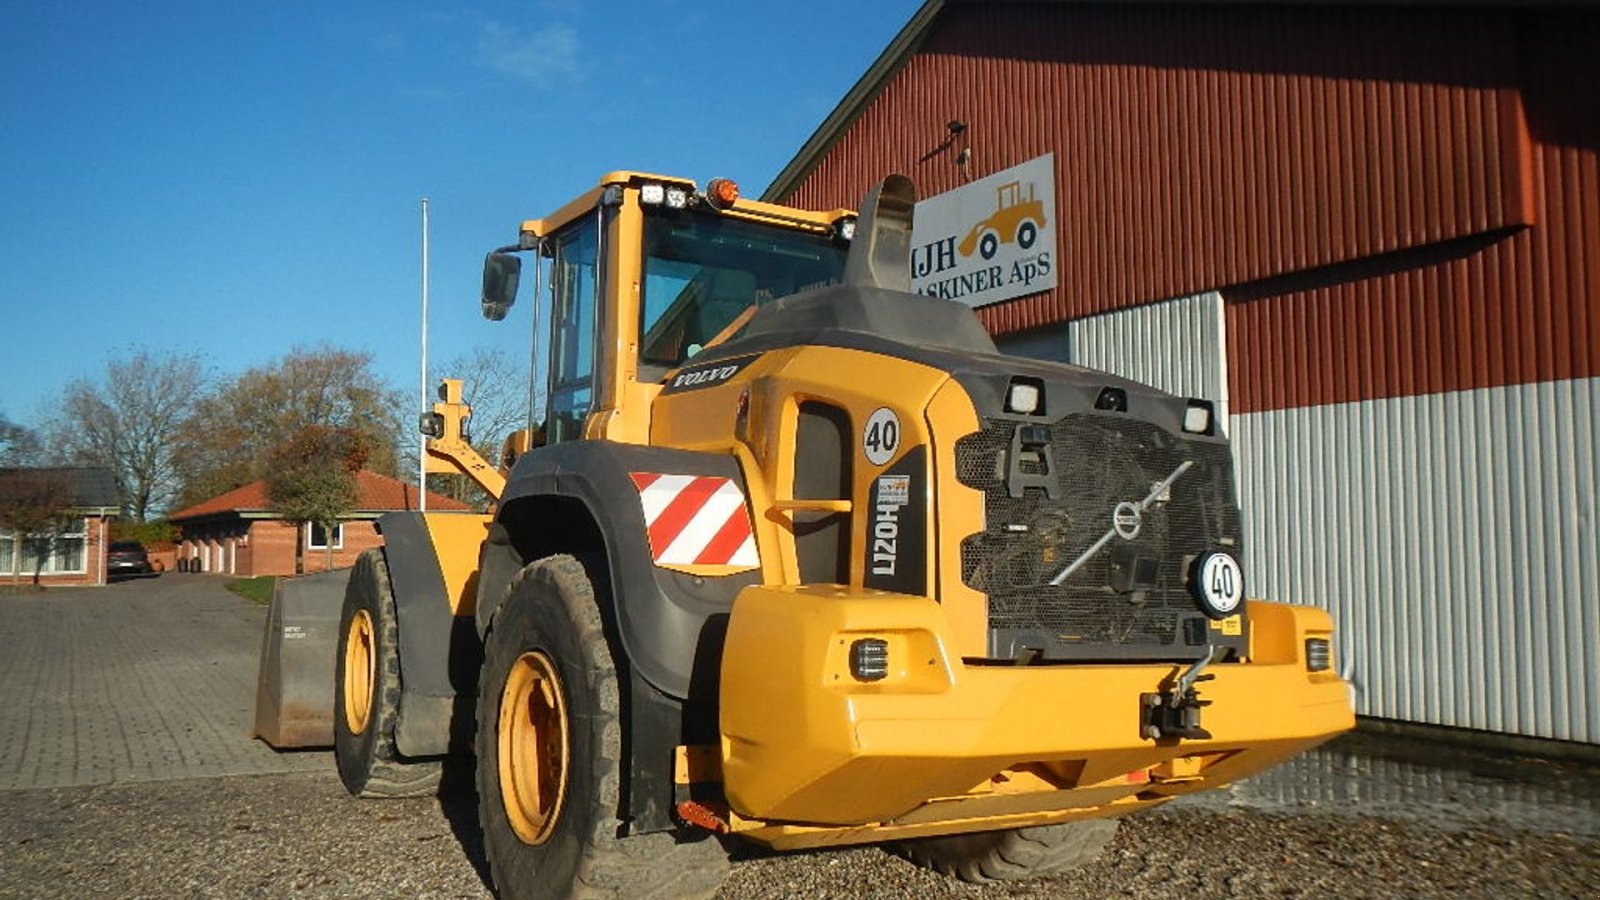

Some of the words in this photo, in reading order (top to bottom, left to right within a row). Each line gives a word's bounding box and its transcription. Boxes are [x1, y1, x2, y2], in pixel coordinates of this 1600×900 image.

[917, 265, 1003, 300] SKINER
[1008, 252, 1051, 287] ApS
[673, 365, 738, 387] VOLVO
[866, 420, 896, 452] 40
[872, 504, 900, 576] L120H
[1212, 564, 1234, 599] 40
